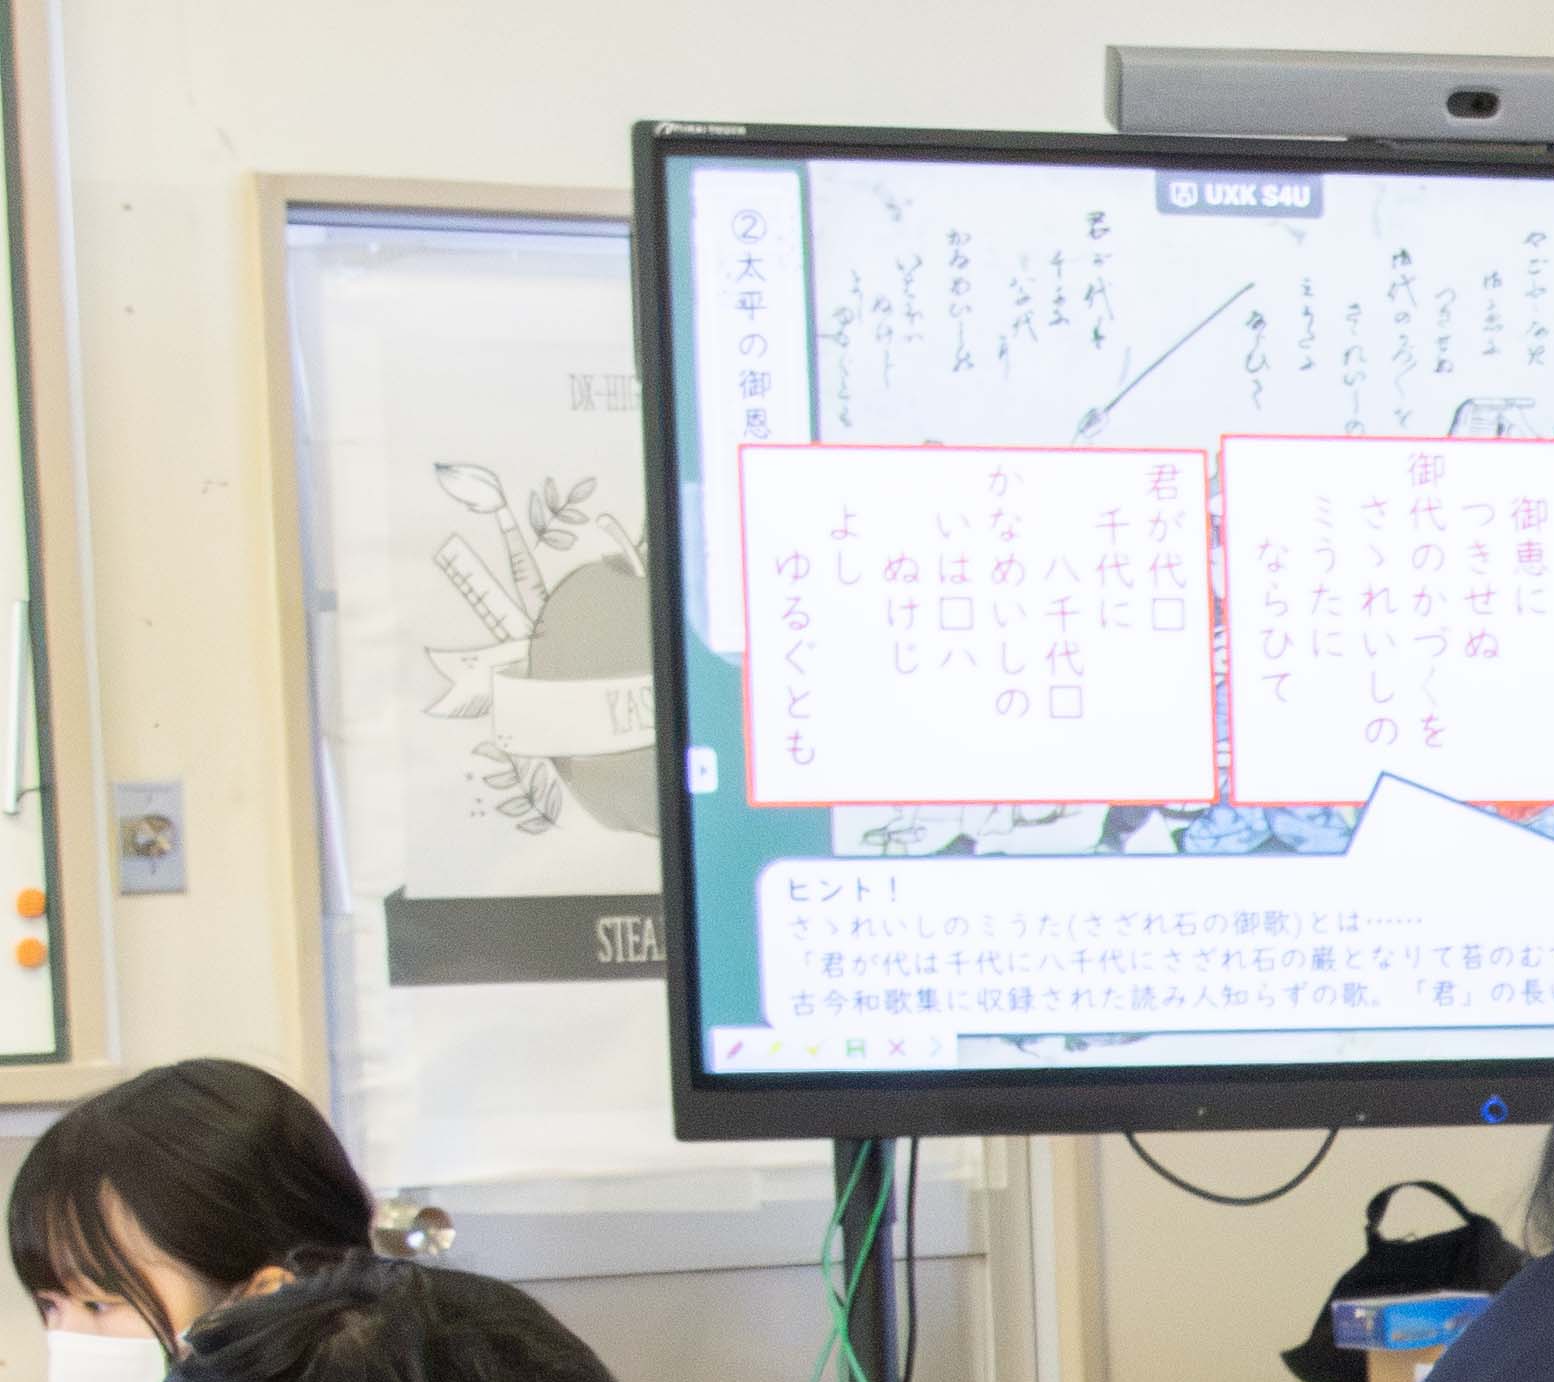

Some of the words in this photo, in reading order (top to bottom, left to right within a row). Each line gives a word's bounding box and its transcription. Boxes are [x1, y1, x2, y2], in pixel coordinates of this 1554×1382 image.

[1204, 183, 1257, 206] UXK
[1261, 184, 1311, 208] S4U
[830, 504, 862, 585] よし
[988, 464, 1030, 717] かなめいしの
[1095, 507, 1134, 629] 千代に
[1462, 503, 1500, 660] つきせぬ
[1510, 497, 1550, 615] 御恵に
[775, 549, 817, 766] ゆるぐとも
[882, 551, 920, 675] ぬけじ
[1257, 538, 1293, 703] ならひて
